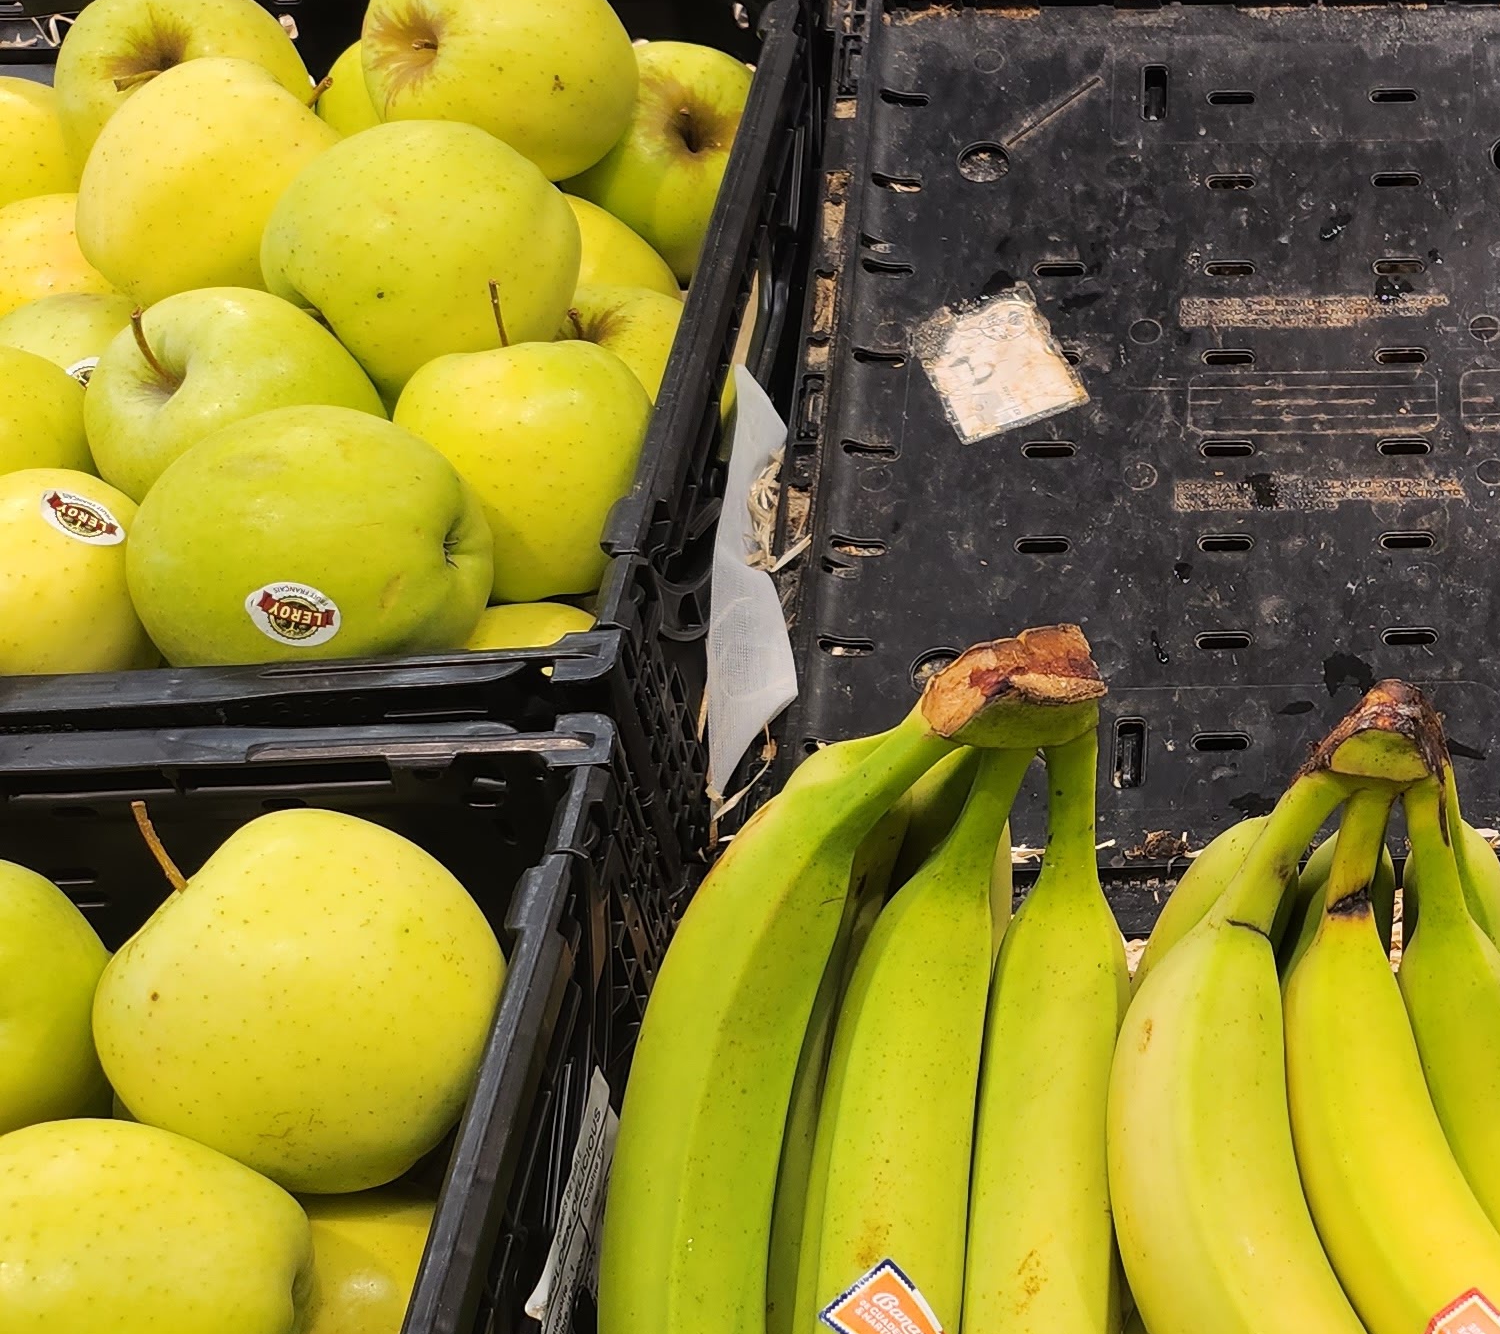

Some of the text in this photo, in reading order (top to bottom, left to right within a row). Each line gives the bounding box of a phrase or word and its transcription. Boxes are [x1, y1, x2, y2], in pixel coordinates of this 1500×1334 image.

[57, 505, 107, 532] LEROY
[272, 585, 329, 608] FRUIT FRANÇAIS
[270, 603, 321, 626] LEROY
[571, 1106, 602, 1216] DELICIOUS
